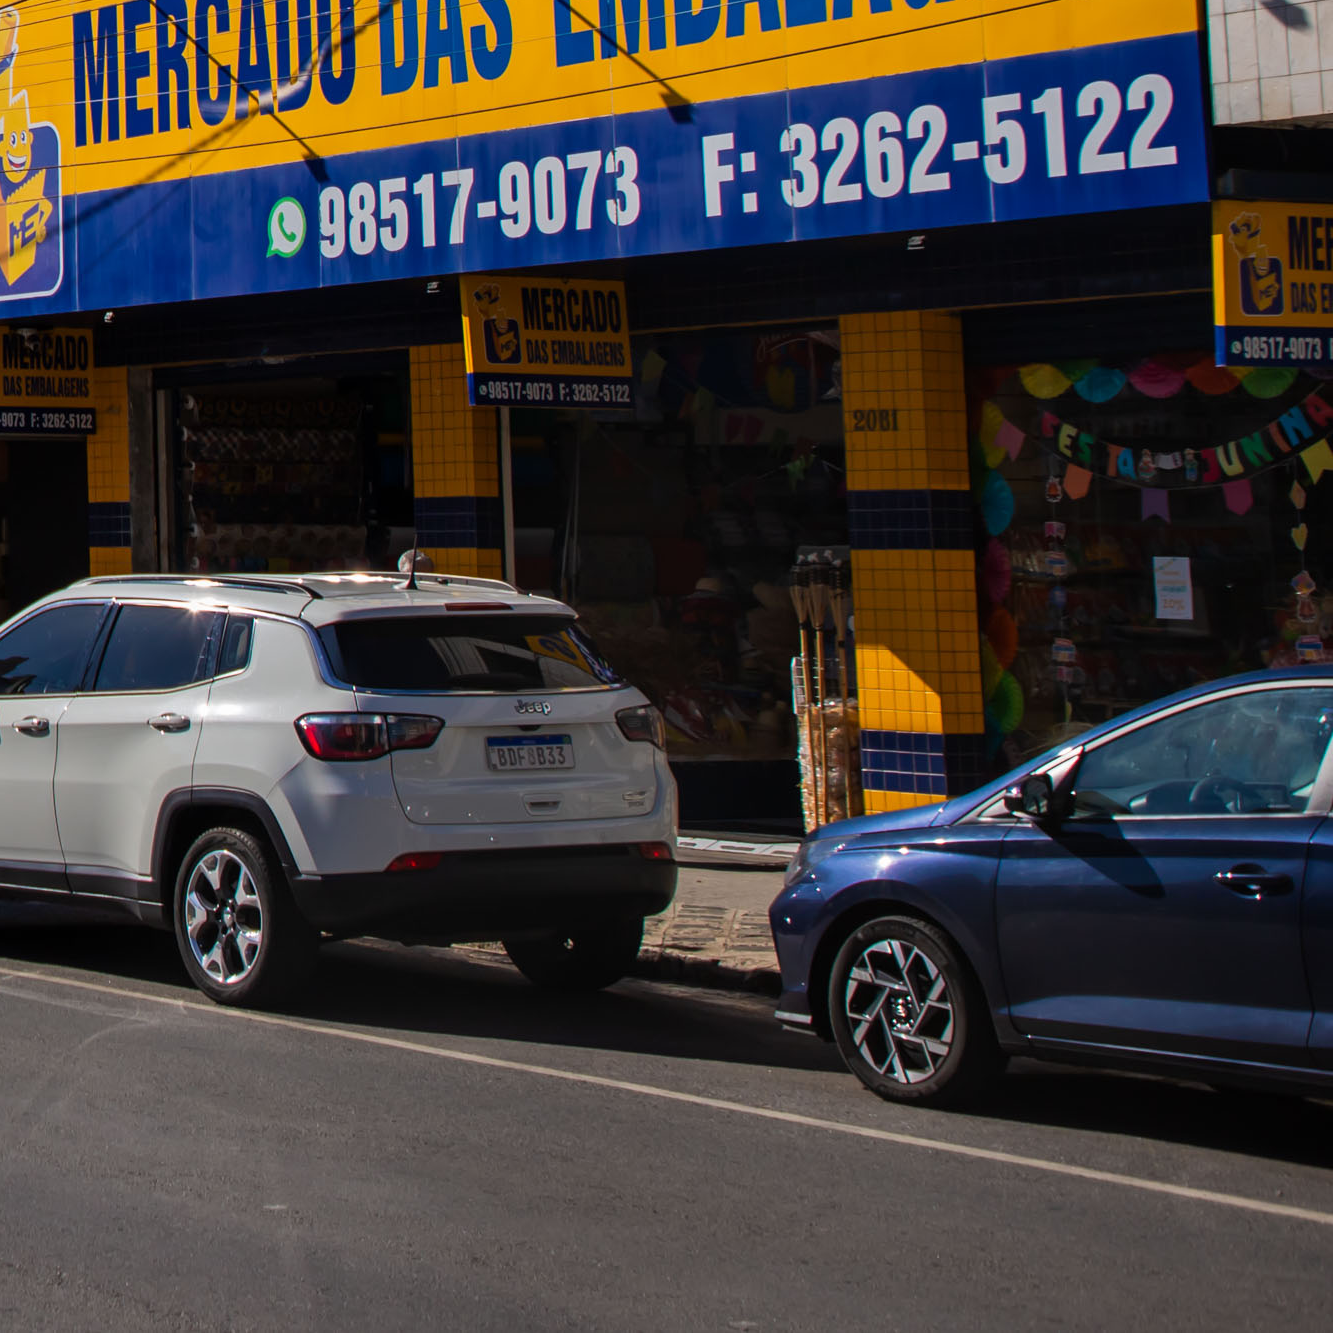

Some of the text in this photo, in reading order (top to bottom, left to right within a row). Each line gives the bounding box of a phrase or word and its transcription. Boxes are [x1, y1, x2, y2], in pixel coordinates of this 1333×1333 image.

[319, 73, 1178, 259] 98517-9073 F: 3262-5122
[520, 287, 622, 333] MERCADO
[1290, 282, 1317, 314] DAS
[2, 333, 89, 371] MERCADO
[525, 339, 625, 366] DAS EMBALAGENS
[1243, 335, 1323, 361] 98517-9073
[3, 376, 90, 398] DAS EMBALAGENS
[488, 380, 630, 402] 98517-9073 F: 3262-5122
[42, 413, 93, 429] 3262-5122
[514, 699, 552, 715] Jeep
[497, 746, 566, 766] BDF8B33
